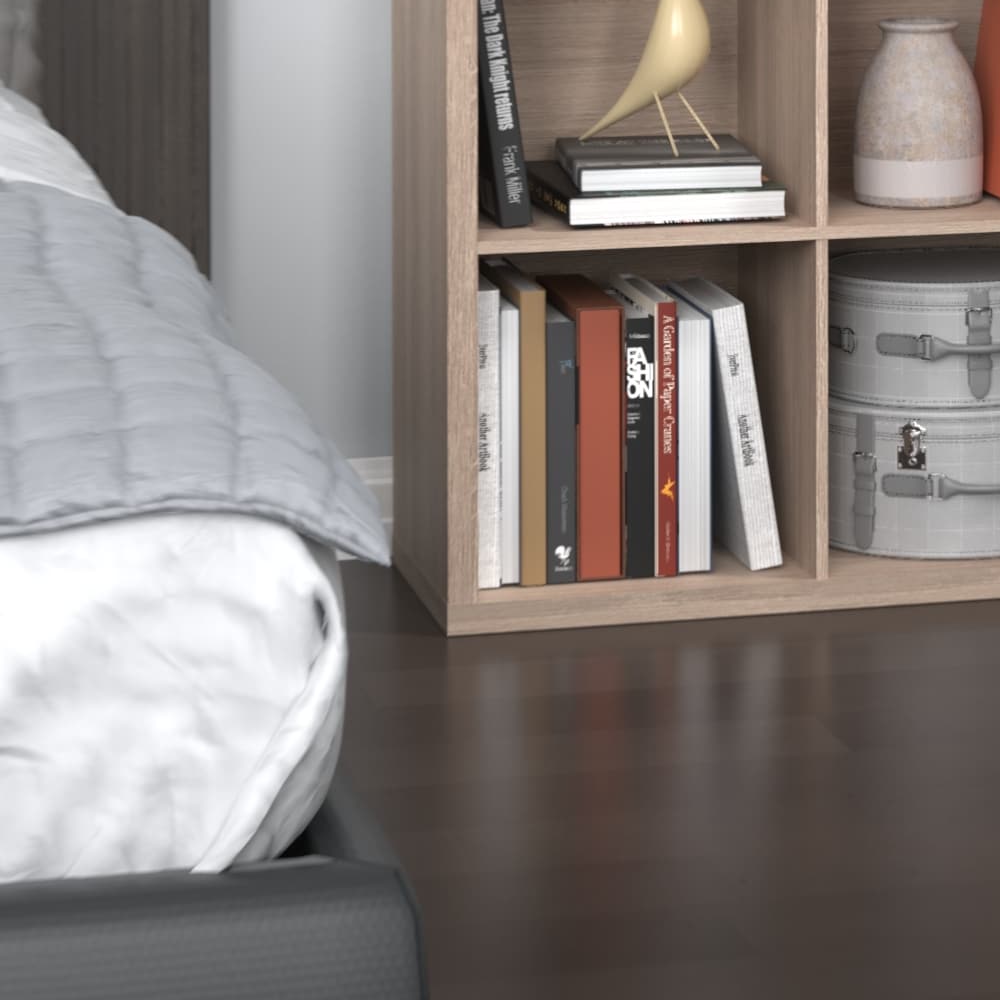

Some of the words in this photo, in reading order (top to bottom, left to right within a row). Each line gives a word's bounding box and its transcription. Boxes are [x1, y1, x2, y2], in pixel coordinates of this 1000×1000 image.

[482, 13, 501, 33] The
[486, 33, 506, 60] Dark
[488, 57, 511, 92] Knight
[494, 89, 514, 132] returns
[502, 144, 520, 174] Frank
[505, 175, 522, 205] Miller
[663, 315, 674, 323] A
[663, 324, 675, 366] Garden
[663, 368, 675, 381] of
[660, 382, 675, 414] Paper
[479, 412, 491, 440] Another
[663, 416, 675, 454] Cranes
